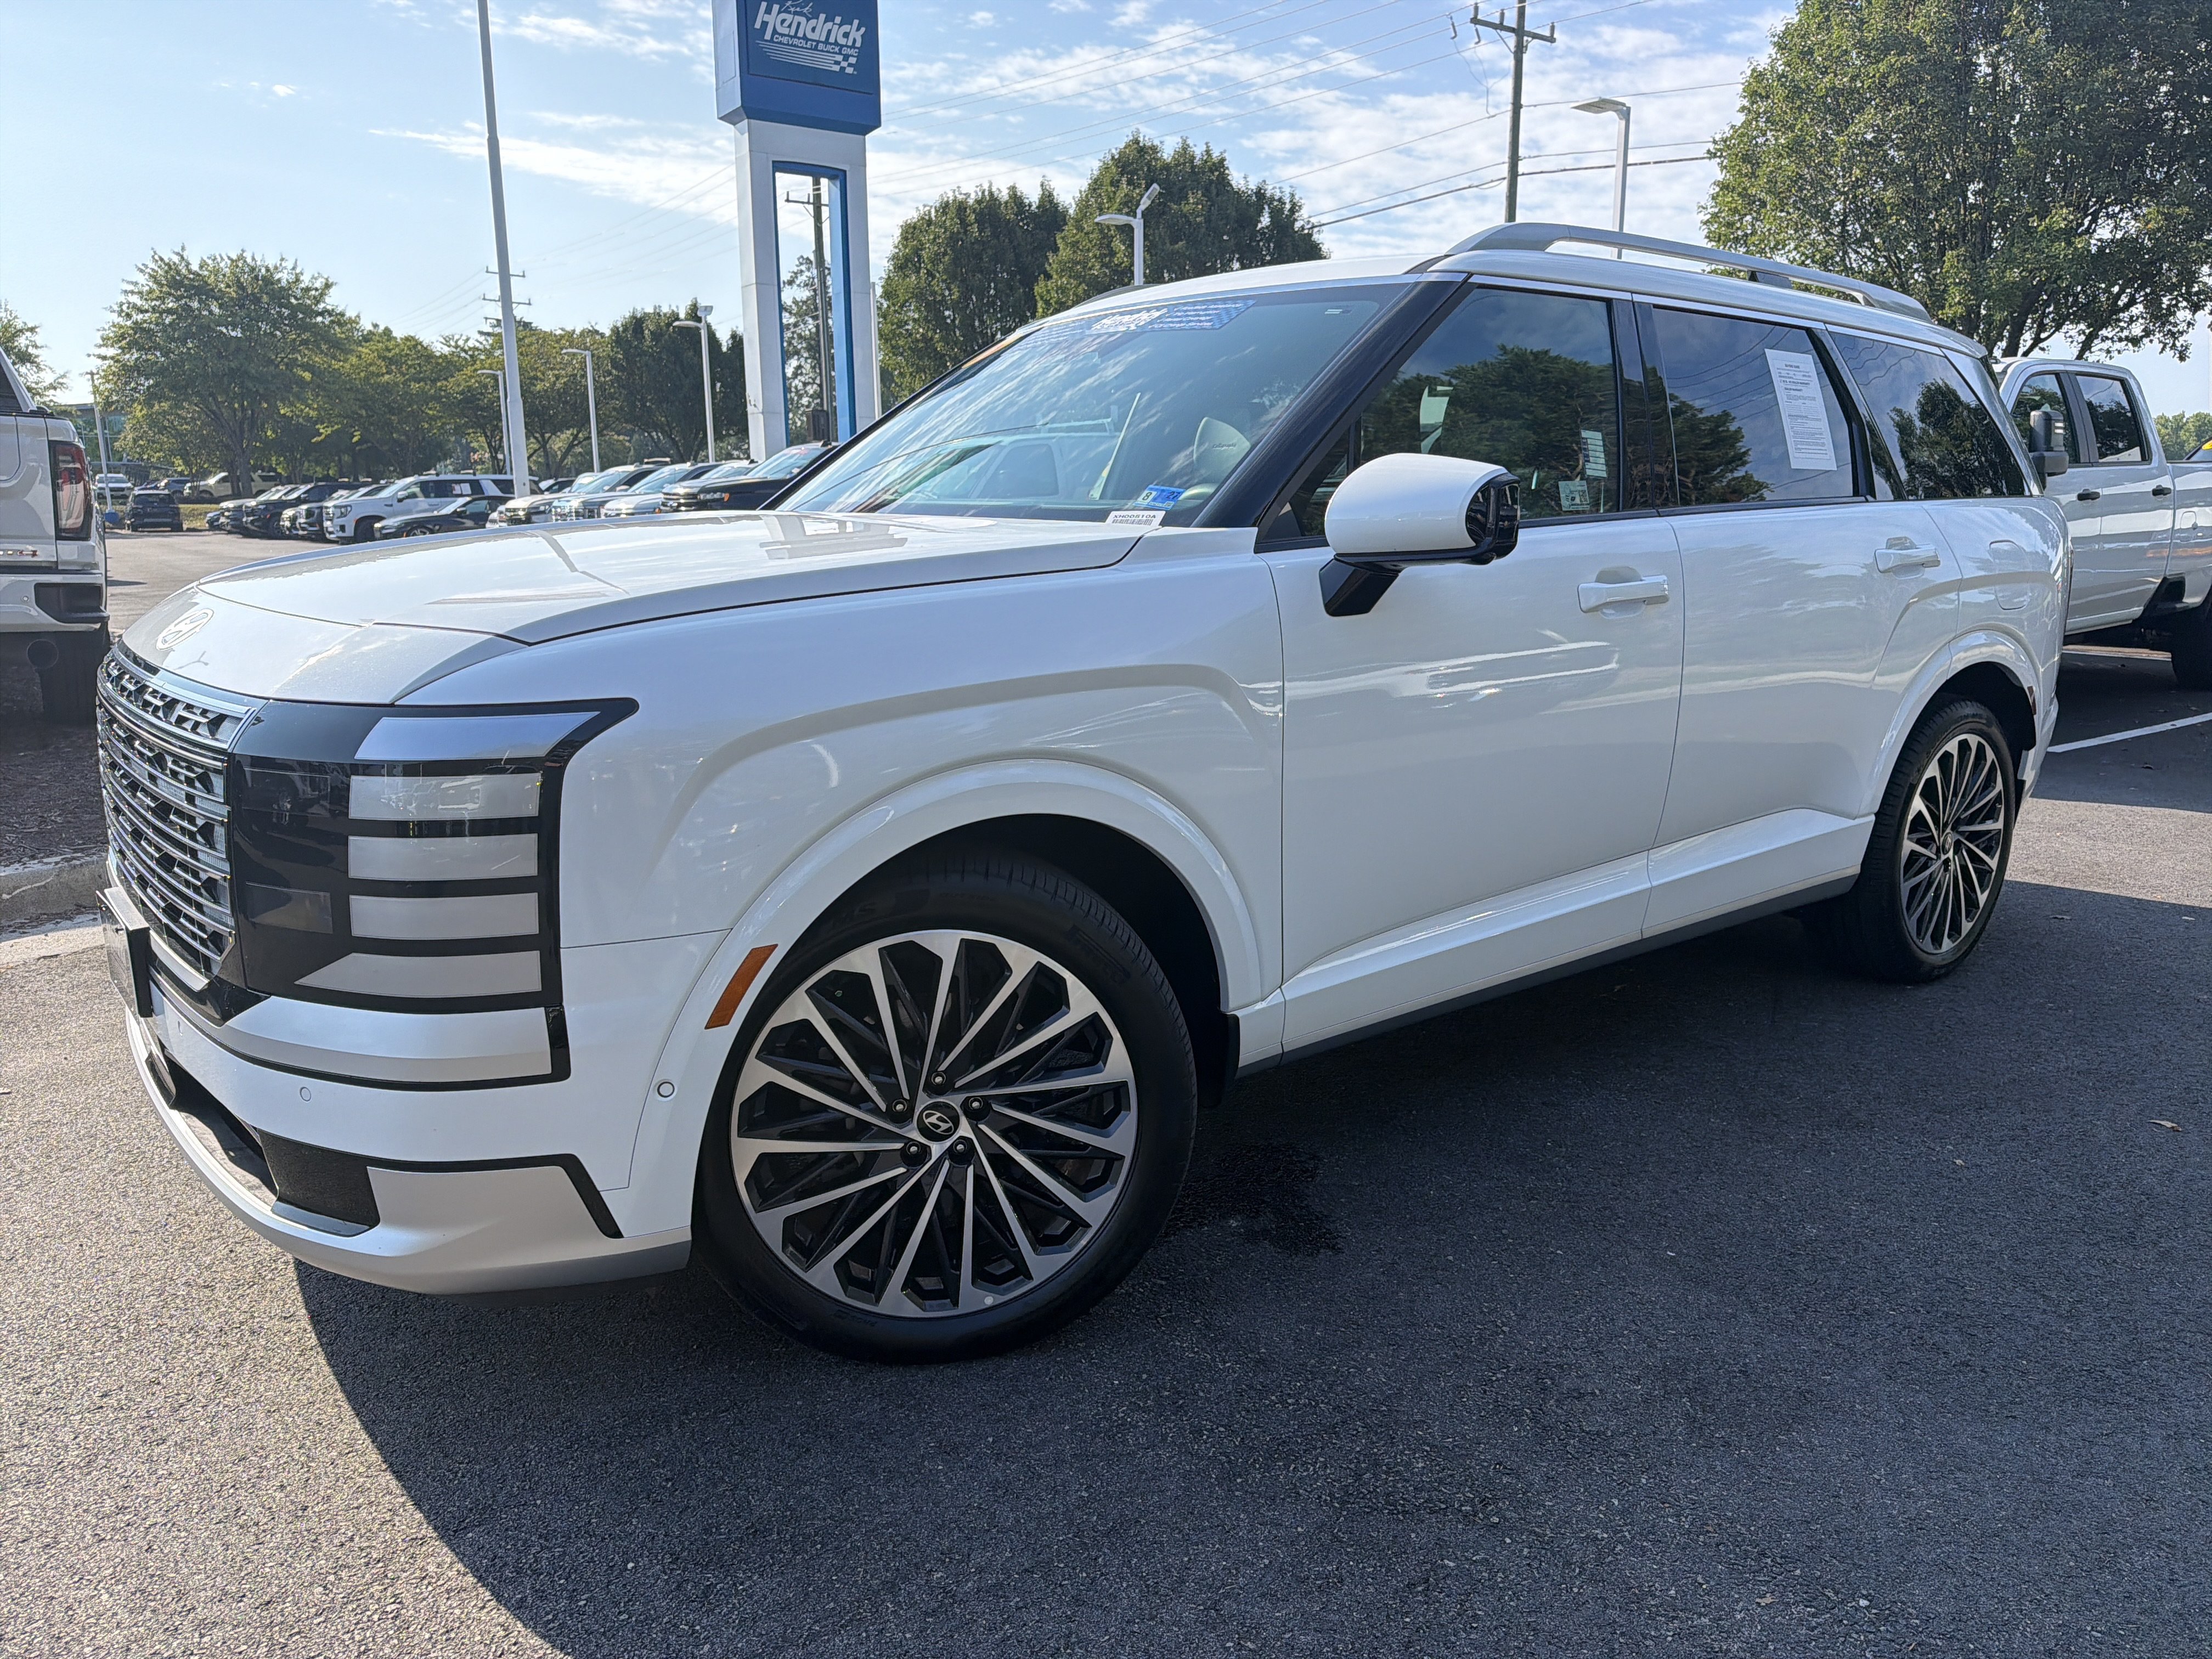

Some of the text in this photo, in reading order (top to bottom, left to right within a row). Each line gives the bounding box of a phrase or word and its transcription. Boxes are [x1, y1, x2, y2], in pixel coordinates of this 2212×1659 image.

[754, 1, 866, 47] Hendrick
[773, 35, 859, 56] CHEVROLET BUICK GMC
[1142, 491, 1181, 500] 8 27
